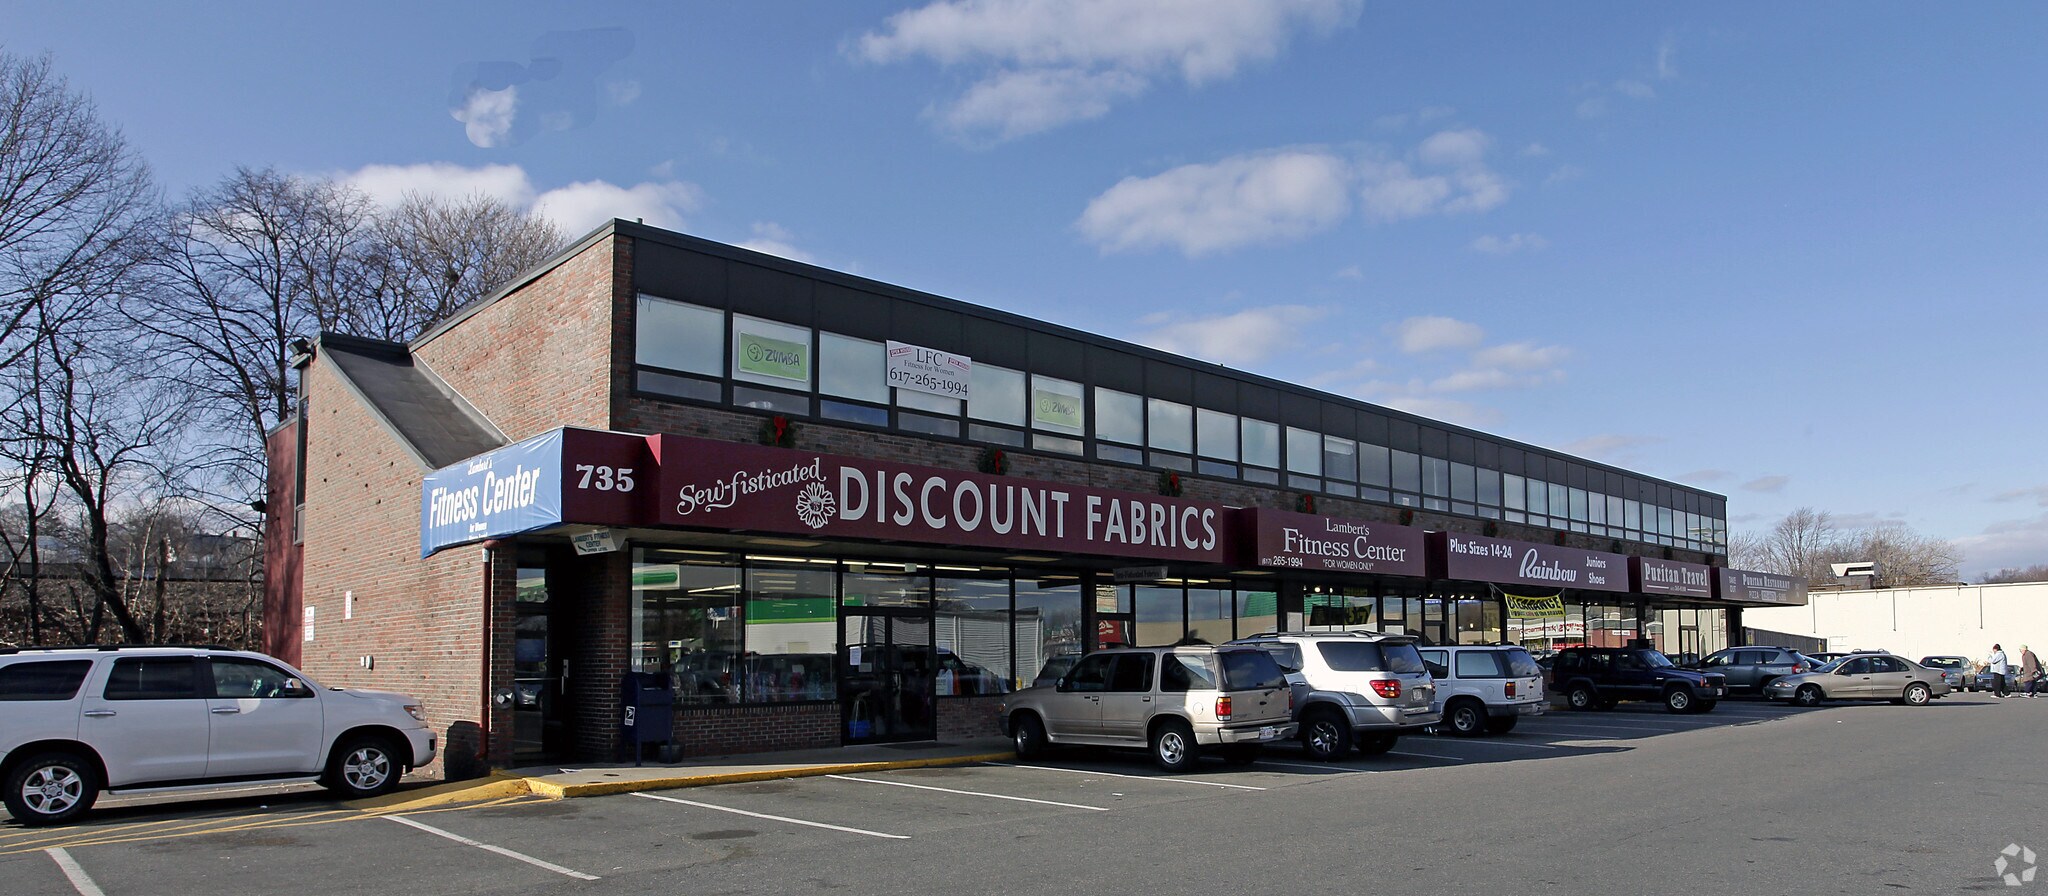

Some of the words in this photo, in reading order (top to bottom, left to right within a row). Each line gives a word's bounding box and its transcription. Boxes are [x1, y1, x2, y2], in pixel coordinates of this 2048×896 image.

[765, 349, 800, 366] ZUMBA
[916, 349, 942, 366] LFC
[904, 360, 923, 371] Fitness
[934, 366, 955, 376] Women
[890, 367, 968, 396] 617-265-1994
[468, 457, 493, 475] Lambert's
[576, 464, 635, 492] 735
[677, 457, 827, 516] Sew-fisticated
[430, 488, 479, 529] Fitness
[482, 465, 540, 516] Center
[840, 466, 1069, 538] DISCOUNT
[1087, 495, 1216, 551] FABRICS
[1326, 518, 1370, 536] Lambert's
[1283, 528, 1349, 557] Fitness
[1354, 536, 1406, 562] Center
[1450, 539, 1467, 553] Plus
[1469, 541, 1489, 556] Sizes
[1491, 544, 1513, 559] 14-24
[1273, 556, 1303, 567] 265-1994
[1337, 560, 1358, 570] WOMEN
[1519, 549, 1577, 582] Rainbow
[1586, 556, 1607, 569] Juniors
[1589, 572, 1605, 585] Shoes
[1645, 563, 1680, 584] Puritan
[1681, 568, 1708, 586] Travel
[1507, 595, 1561, 610] CLEARANCE
